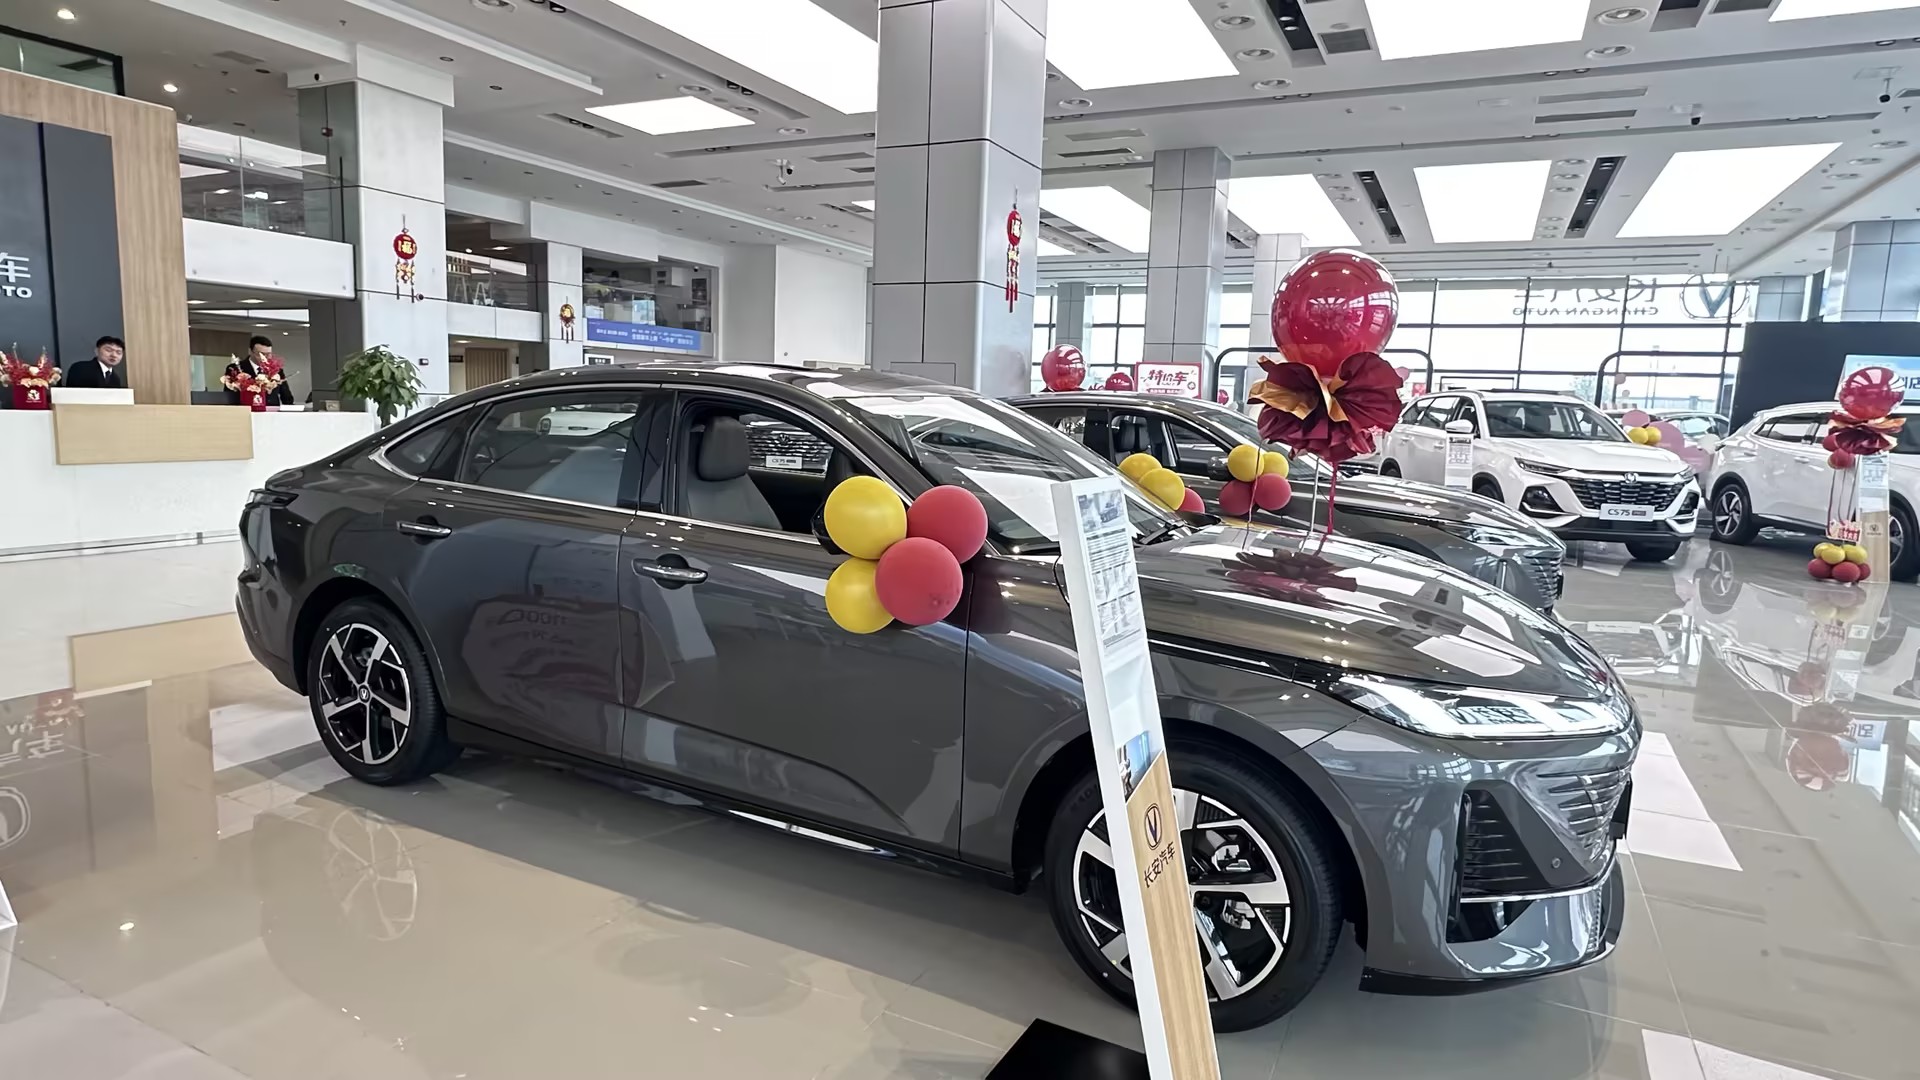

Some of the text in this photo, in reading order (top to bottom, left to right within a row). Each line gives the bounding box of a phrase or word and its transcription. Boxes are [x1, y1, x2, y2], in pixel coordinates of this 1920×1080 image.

[0, 285, 32, 298] TO
[1147, 369, 1189, 386] 特价车
[1143, 841, 1176, 889] 长安汽车
